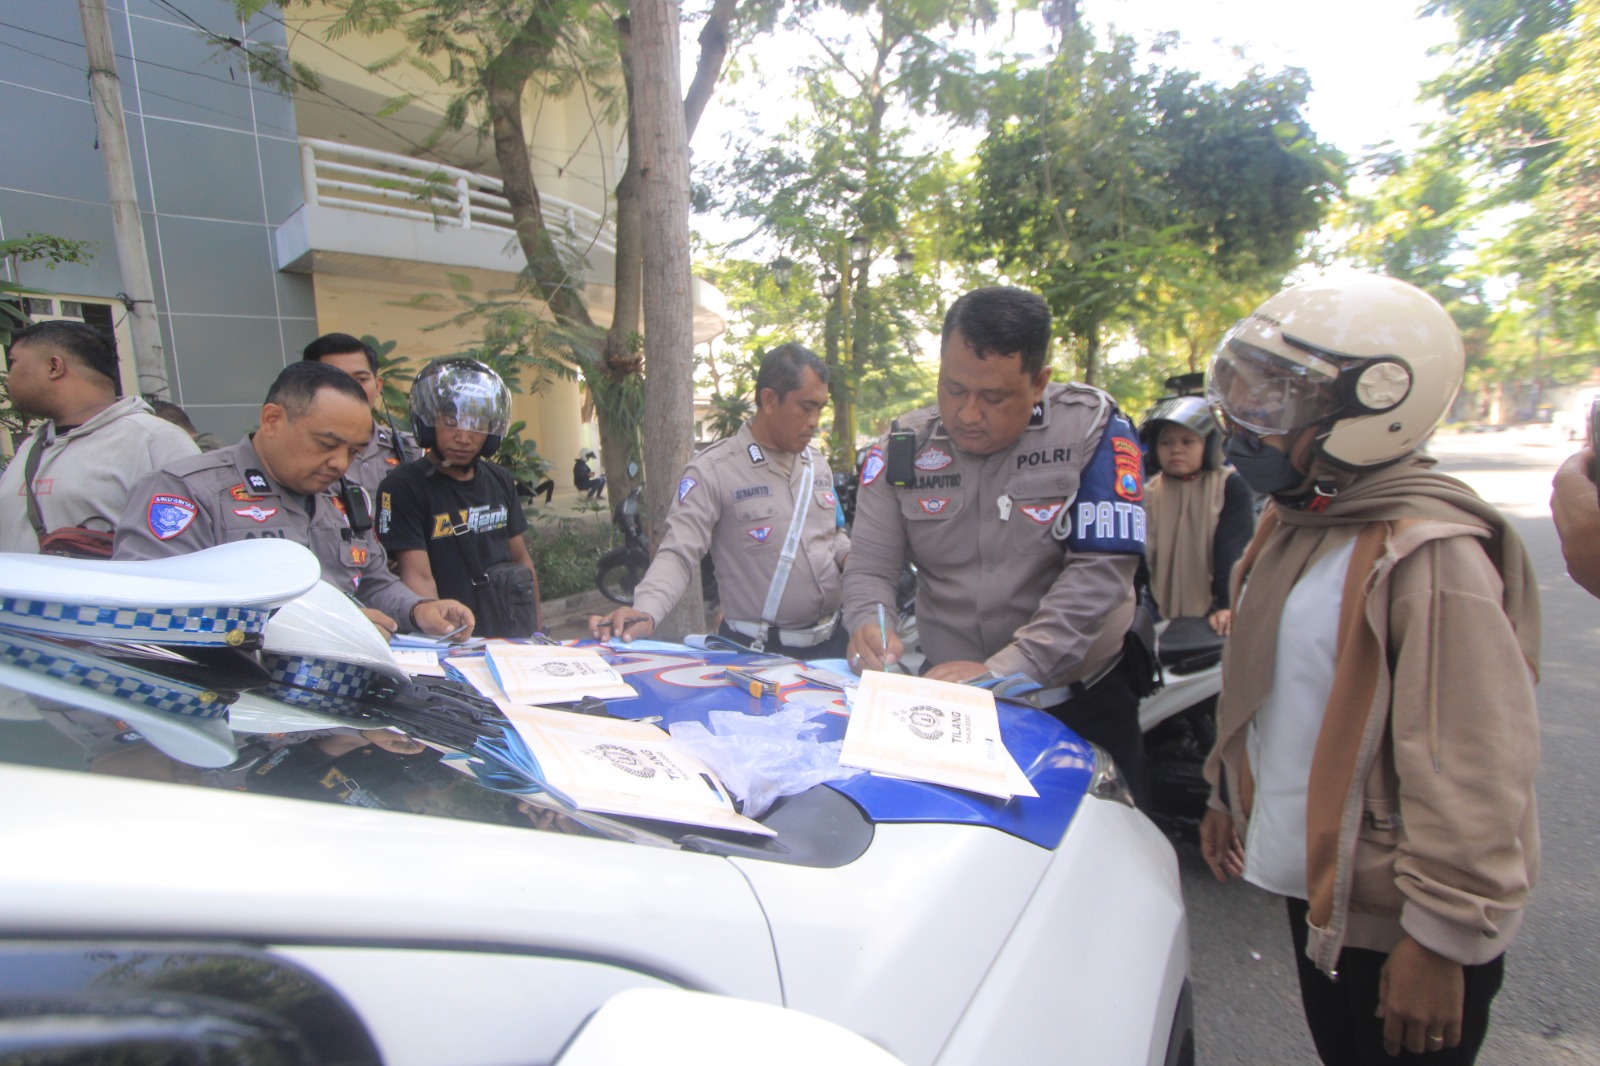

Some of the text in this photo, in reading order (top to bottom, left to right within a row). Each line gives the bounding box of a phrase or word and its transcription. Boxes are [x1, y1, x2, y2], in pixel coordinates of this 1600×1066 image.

[1017, 448, 1071, 469] POLRI
[736, 486, 769, 500] SUMANTO
[951, 711, 962, 744] TILANG
